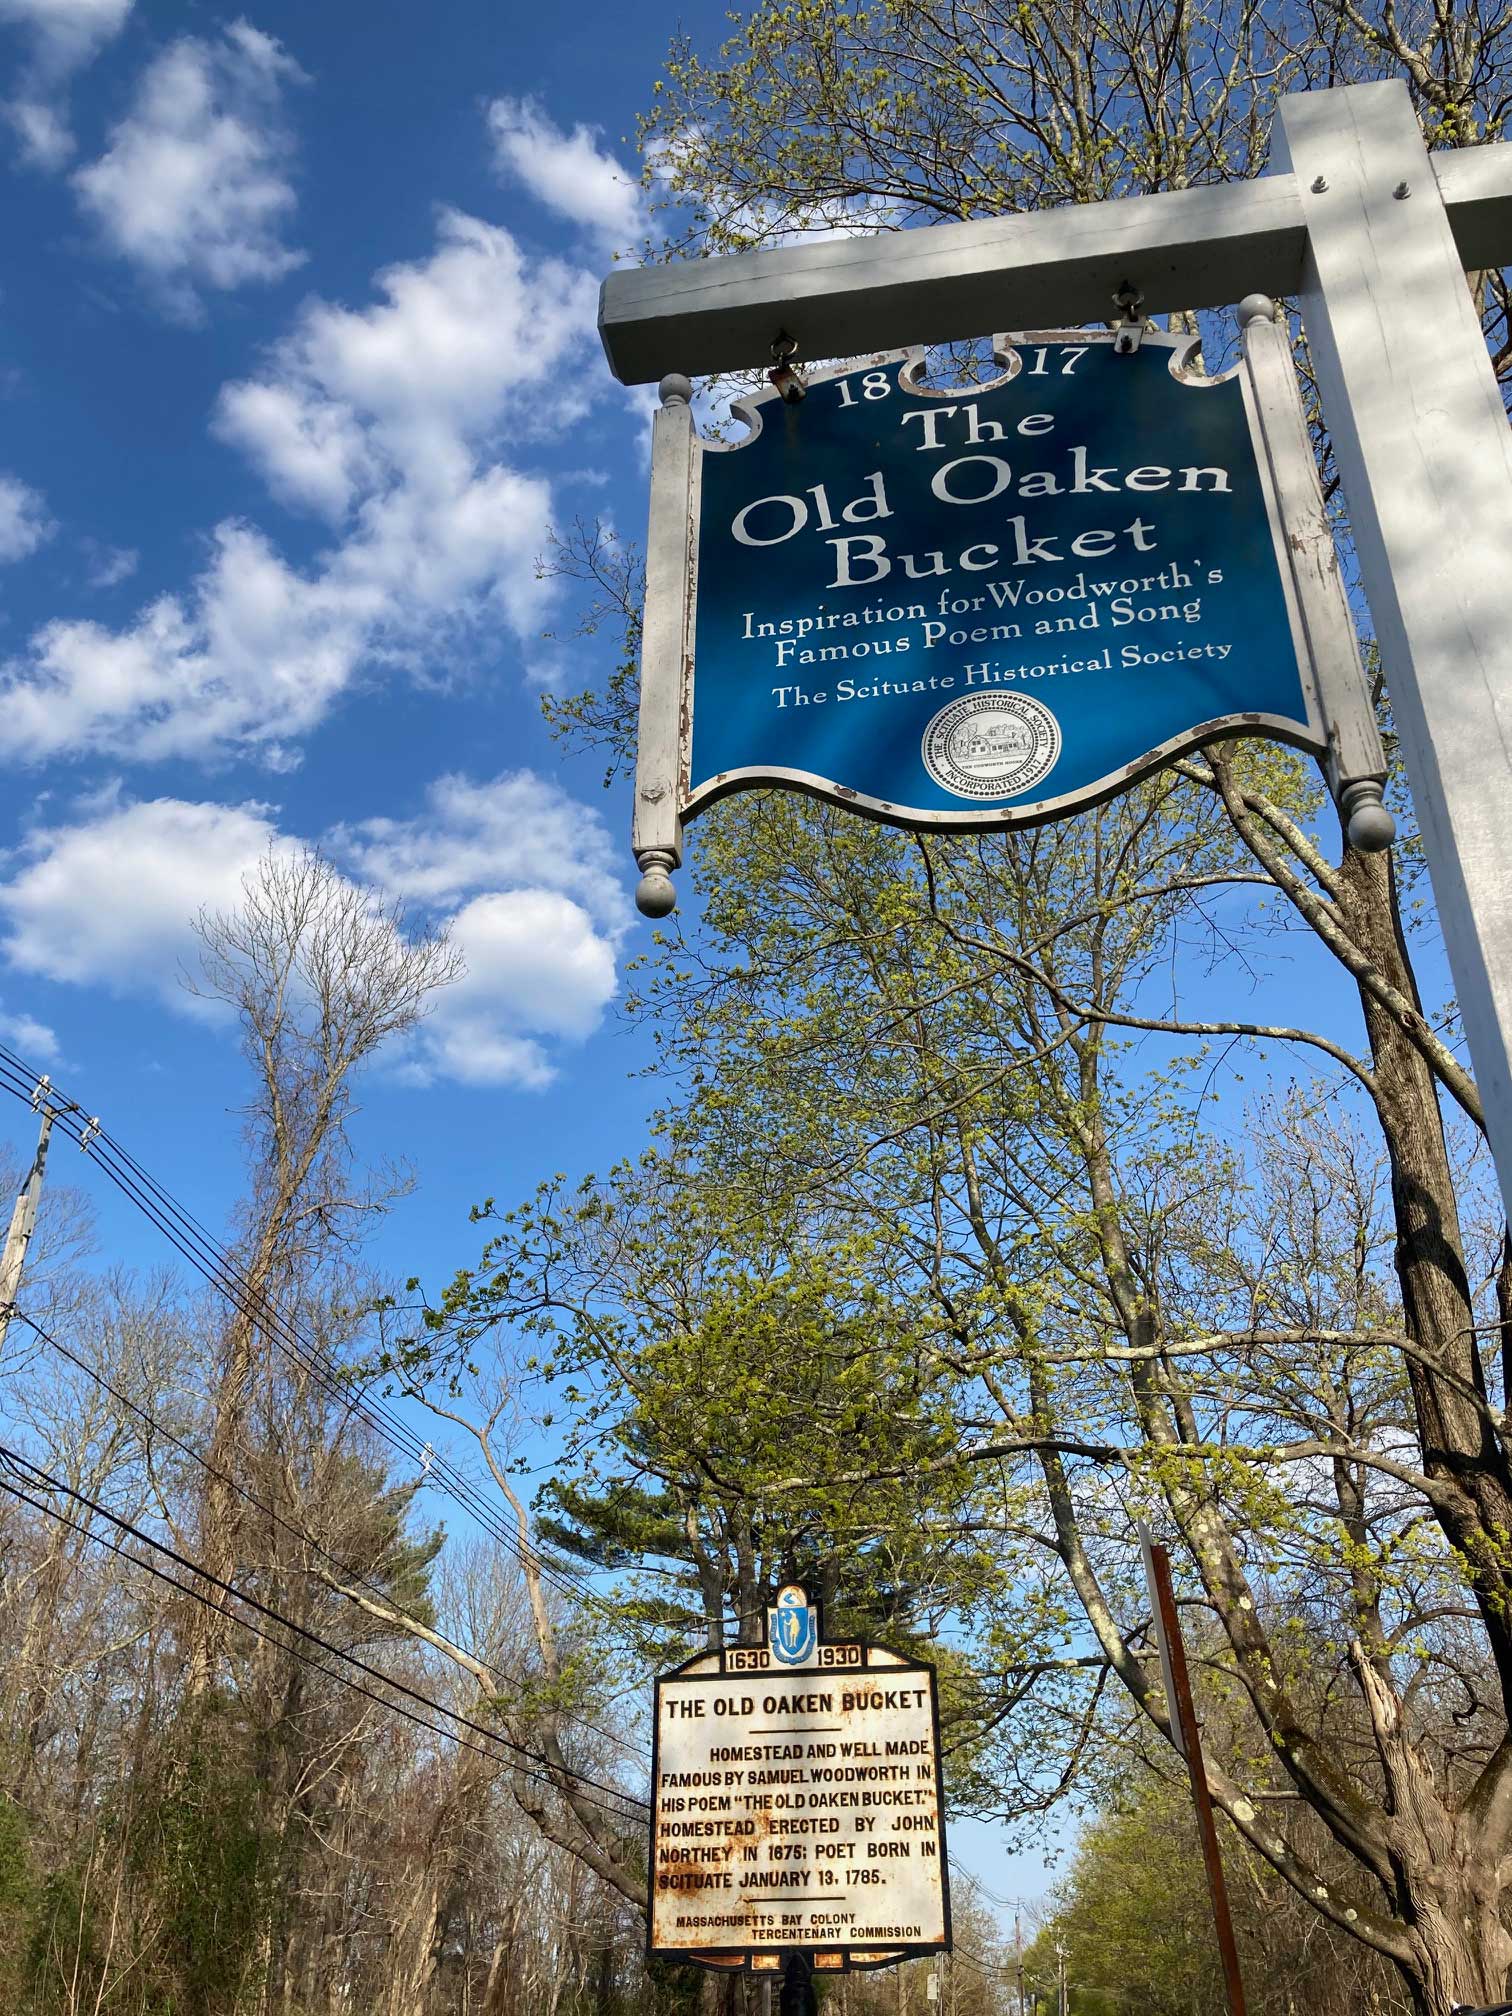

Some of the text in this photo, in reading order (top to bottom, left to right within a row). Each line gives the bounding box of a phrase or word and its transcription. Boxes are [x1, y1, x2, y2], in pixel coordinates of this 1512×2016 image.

[835, 347, 1089, 408] 18 17
[901, 402, 1056, 452] The
[731, 445, 1233, 546] Old Oaken
[824, 515, 1158, 589] Bucket
[741, 561, 1224, 641] Inspiration for Woodworth's
[775, 597, 1202, 668] Famous Poem and Song
[771, 639, 1233, 710] The Scituate Historical Society
[934, 699, 1048, 760] THE SCITUATE HISTORICAL SOCIETY
[945, 770, 1022, 791] INCORPORATED
[1022, 759, 1042, 778] 1917
[729, 1647, 859, 1671] 1630 1930
[666, 1690, 927, 1719] THE OLD OAKEN BUCKET
[710, 1740, 929, 1763] HOMESTEAD AND WELL MADE
[661, 1765, 931, 1788] FAMOUS BY SAMUEL WOODWORTH IN
[661, 1797, 686, 1812] HIS
[688, 1795, 730, 1811] POEM
[775, 1792, 804, 1808] OLD
[808, 1791, 859, 1807] OAKEN
[660, 1815, 934, 1838] HOMESTEAD ERECTED BY JOHN
[659, 1846, 734, 1863] NORTHEY
[743, 1846, 758, 1861] IN
[815, 1842, 856, 1859] POET
[867, 1842, 910, 1857] BORN
[921, 1841, 936, 1857] IN
[658, 1872, 732, 1889] SCITUATE
[739, 1870, 811, 1888] JANUARY
[846, 1869, 887, 1884] 1785.
[676, 1913, 856, 1928] MASSACHUSETTS BAY COLONY
[752, 1926, 922, 1940] TERCENTENARY COMMISSION
